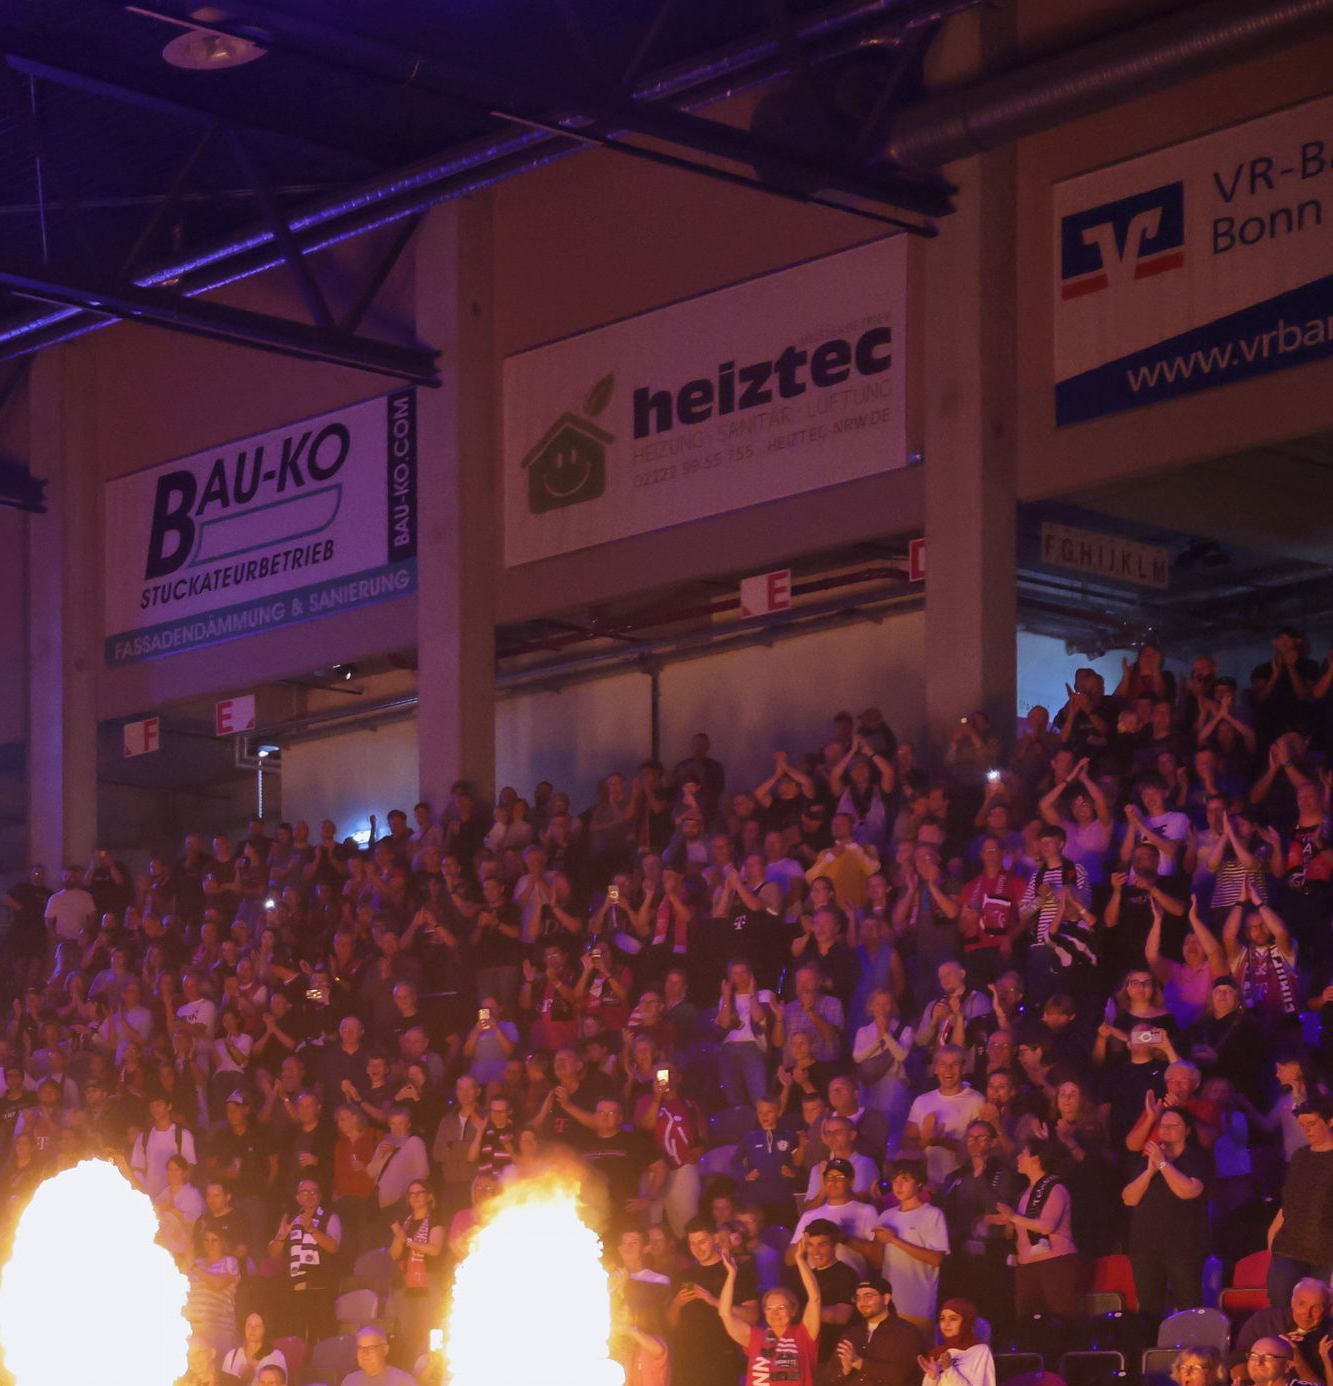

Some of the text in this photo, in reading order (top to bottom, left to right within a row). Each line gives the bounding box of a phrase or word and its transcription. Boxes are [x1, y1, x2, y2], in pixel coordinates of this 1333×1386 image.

[1212, 140, 1333, 203] VR-B
[1212, 199, 1323, 255] Bonn
[633, 325, 892, 440] heiztec
[1126, 315, 1333, 392] www.vrba
[144, 422, 351, 581] BAU-KO
[394, 397, 410, 547] BAU-KO.COM
[140, 538, 334, 610] STUCKATEURBETRIEB
[768, 571, 790, 612] E
[113, 601, 286, 661] FASSADENDÄMMUNG
[309, 568, 410, 613] SANIERUNG
[144, 719, 158, 751] F
[217, 701, 233, 734] E
